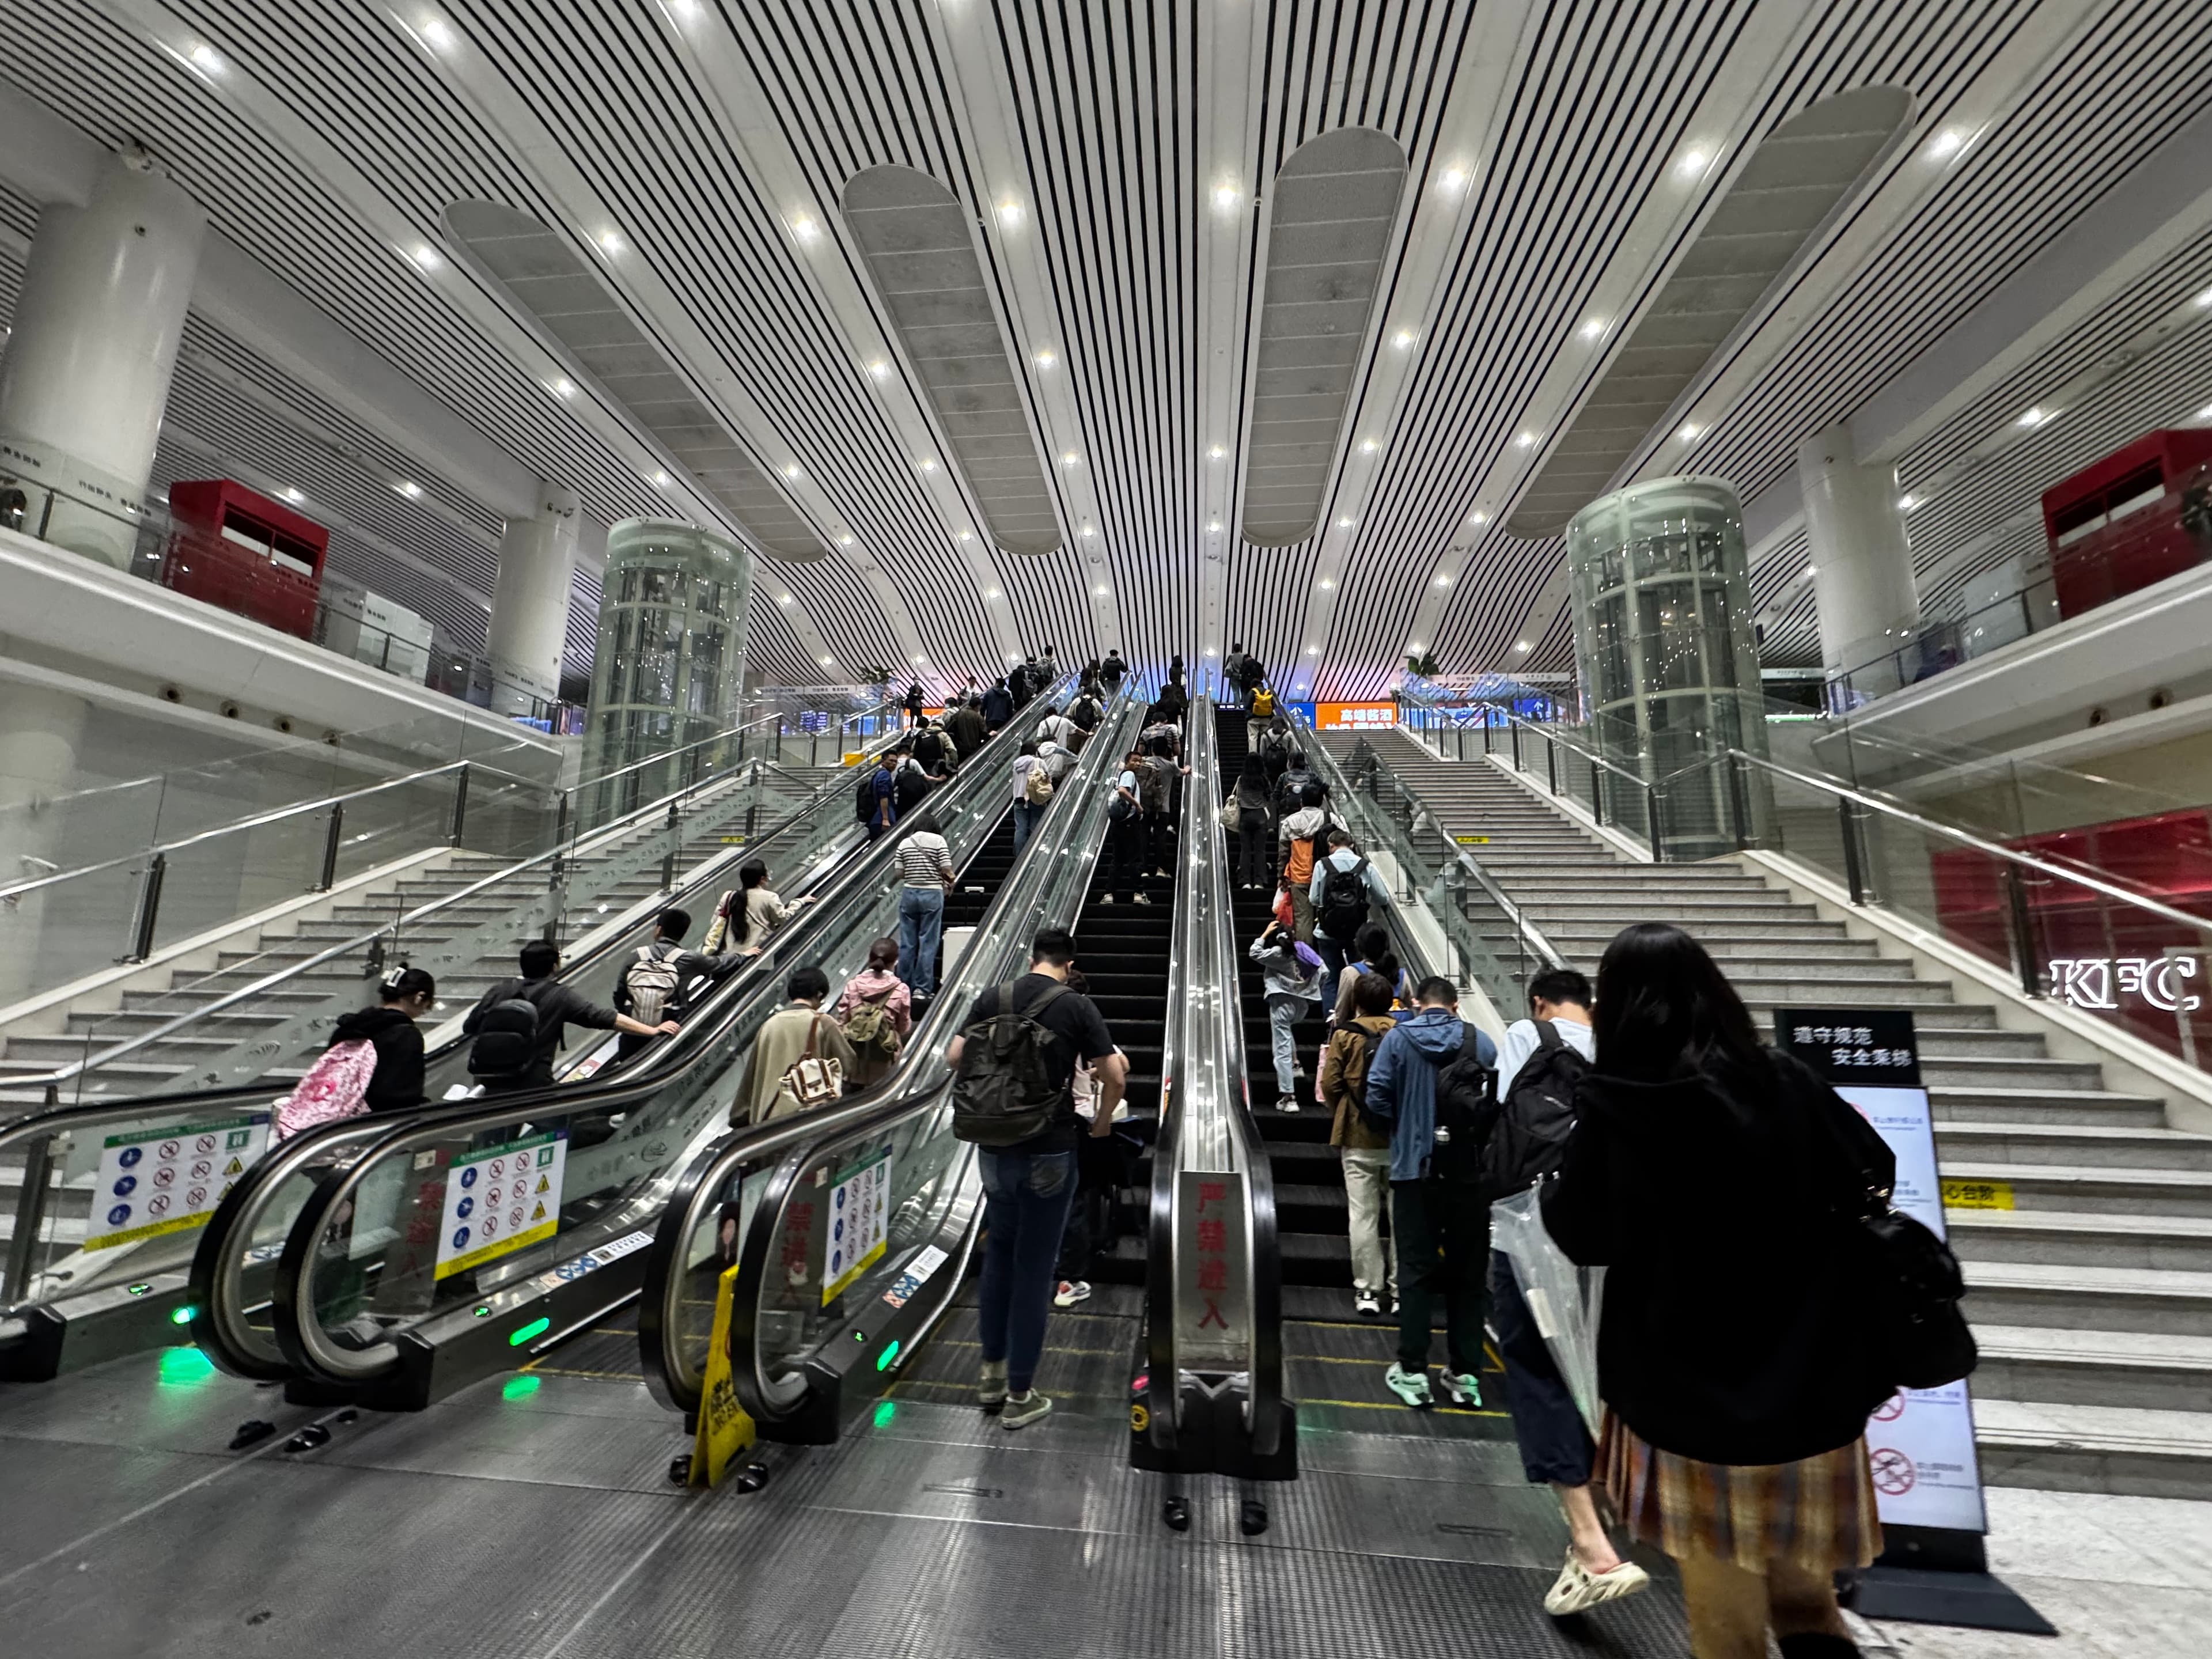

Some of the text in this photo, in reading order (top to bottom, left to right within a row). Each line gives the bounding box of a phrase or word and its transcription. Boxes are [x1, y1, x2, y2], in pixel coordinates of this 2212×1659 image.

[2049, 957, 2200, 1010] KFC
[1793, 1025, 1873, 1046] 遵守规范
[1831, 1047, 1912, 1067] 安全乘梯
[1198, 1183, 1229, 1330] 严禁进入
